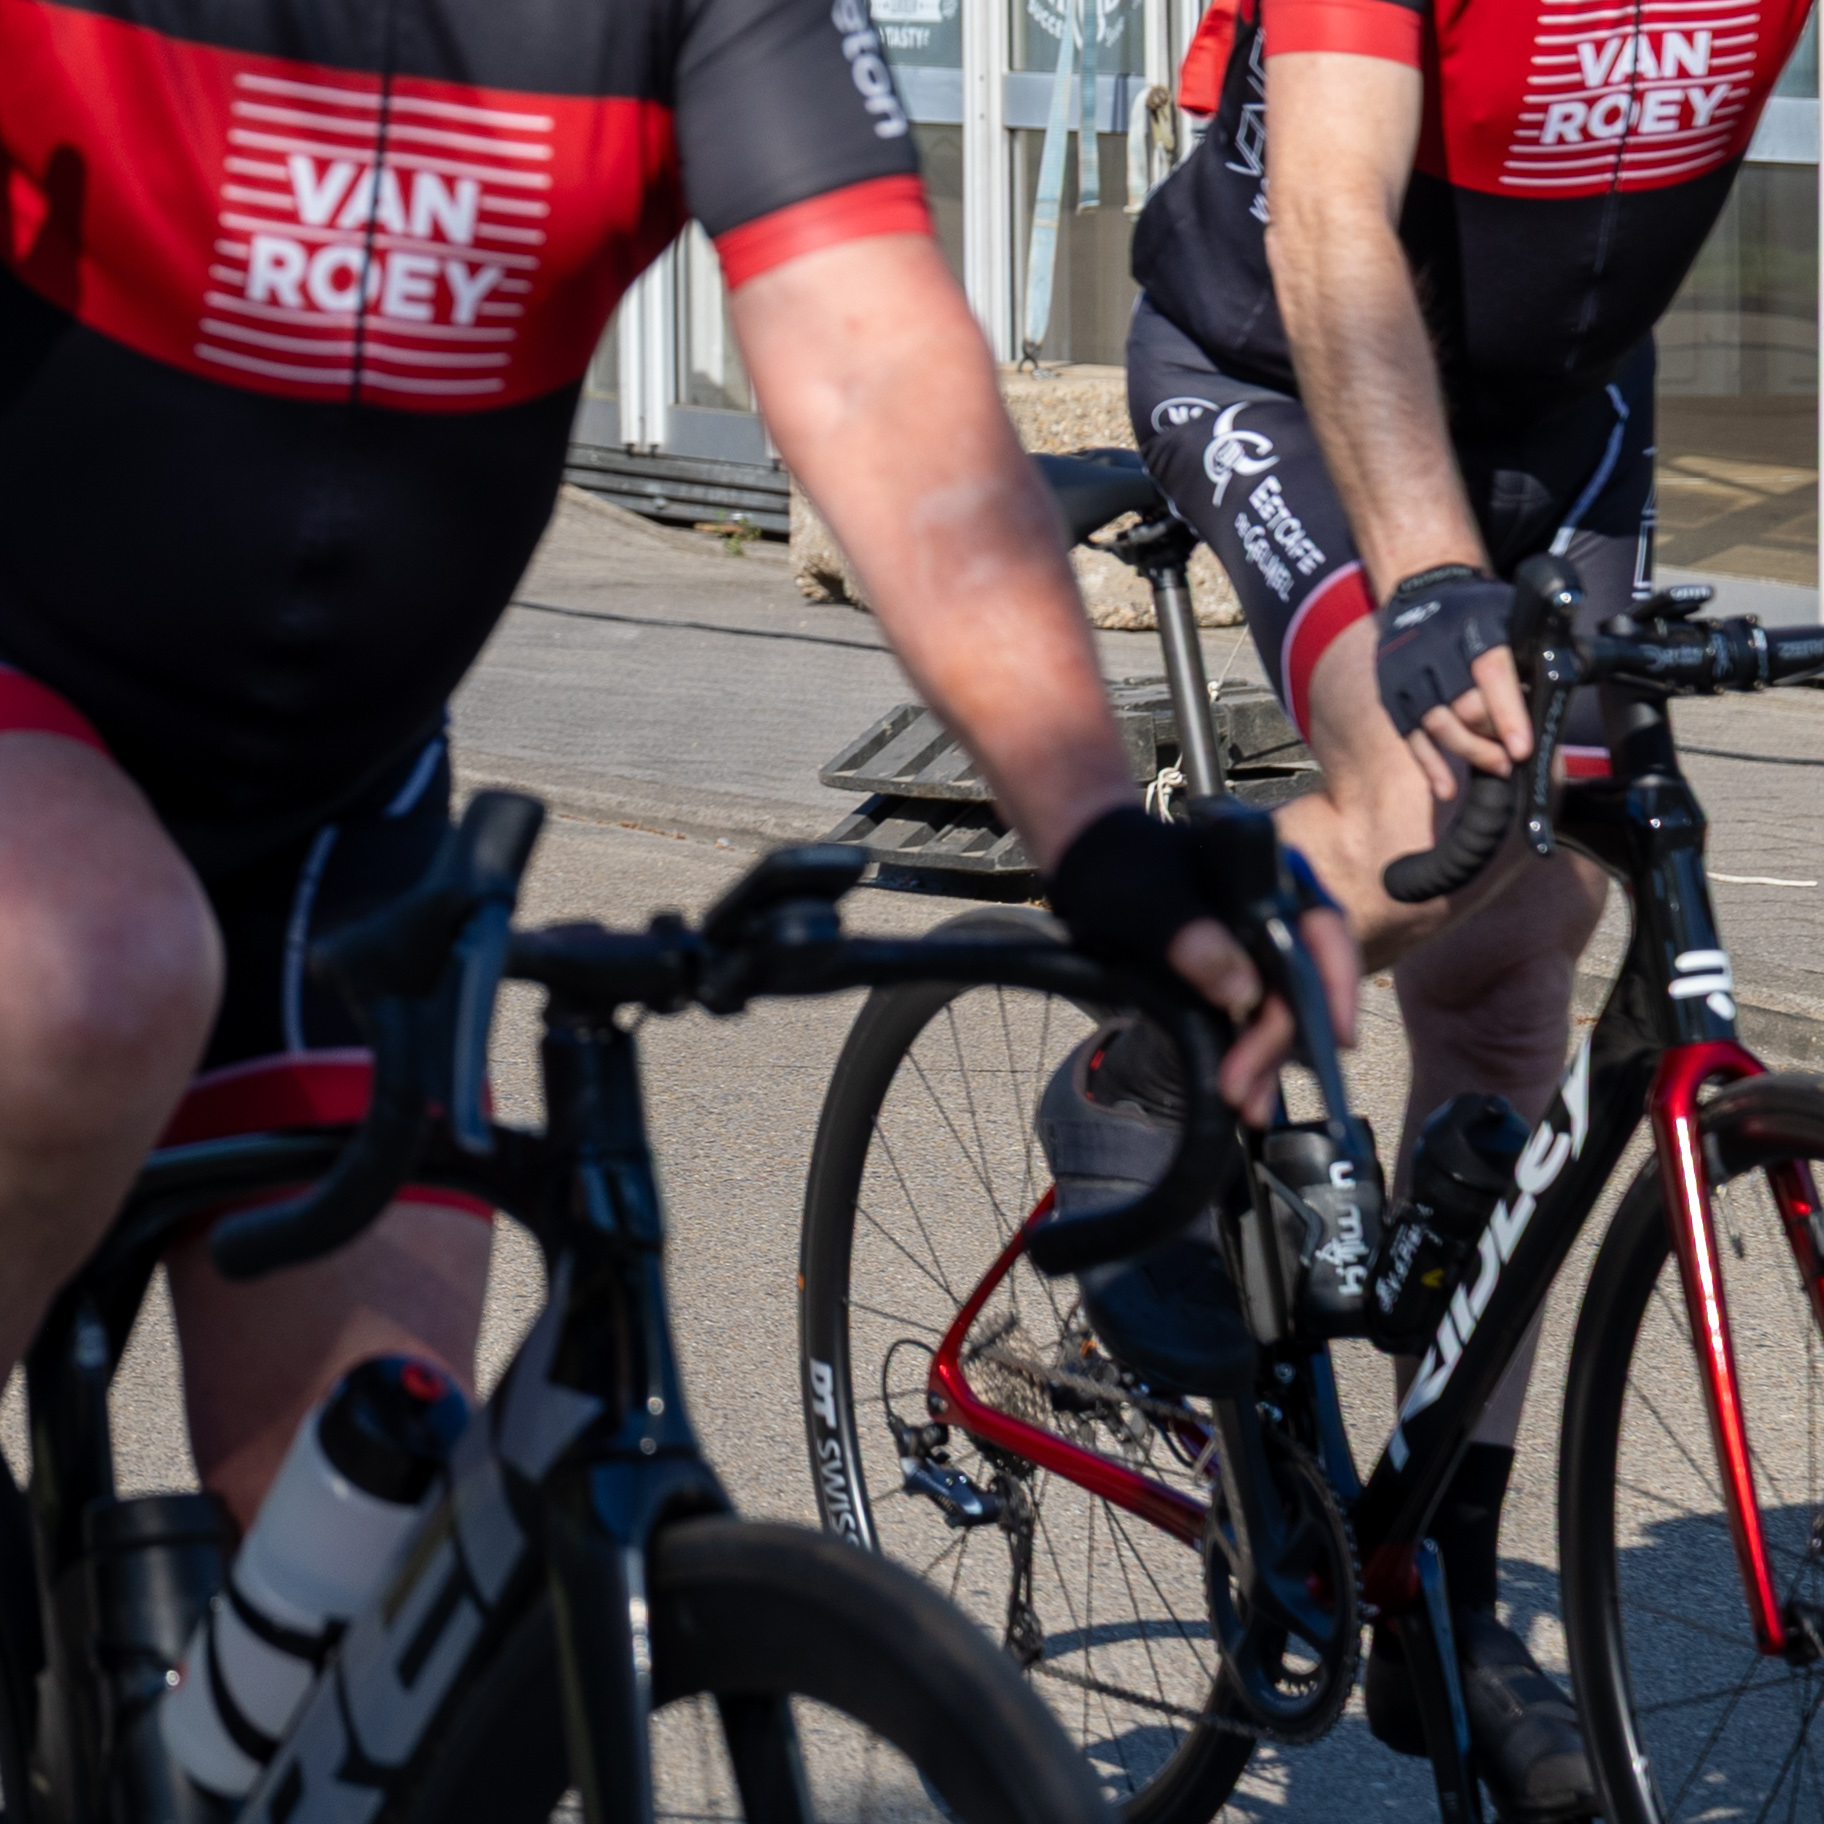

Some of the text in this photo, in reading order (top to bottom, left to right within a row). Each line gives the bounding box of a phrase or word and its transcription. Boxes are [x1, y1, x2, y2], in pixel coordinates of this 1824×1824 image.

[1577, 30, 1712, 88] VAN
[1539, 82, 1732, 145] ROEY
[287, 153, 480, 246] VAN
[245, 233, 505, 327] ROEY
[1388, 1034, 1591, 1473] RIDLEY
[809, 1357, 837, 1430] DT
